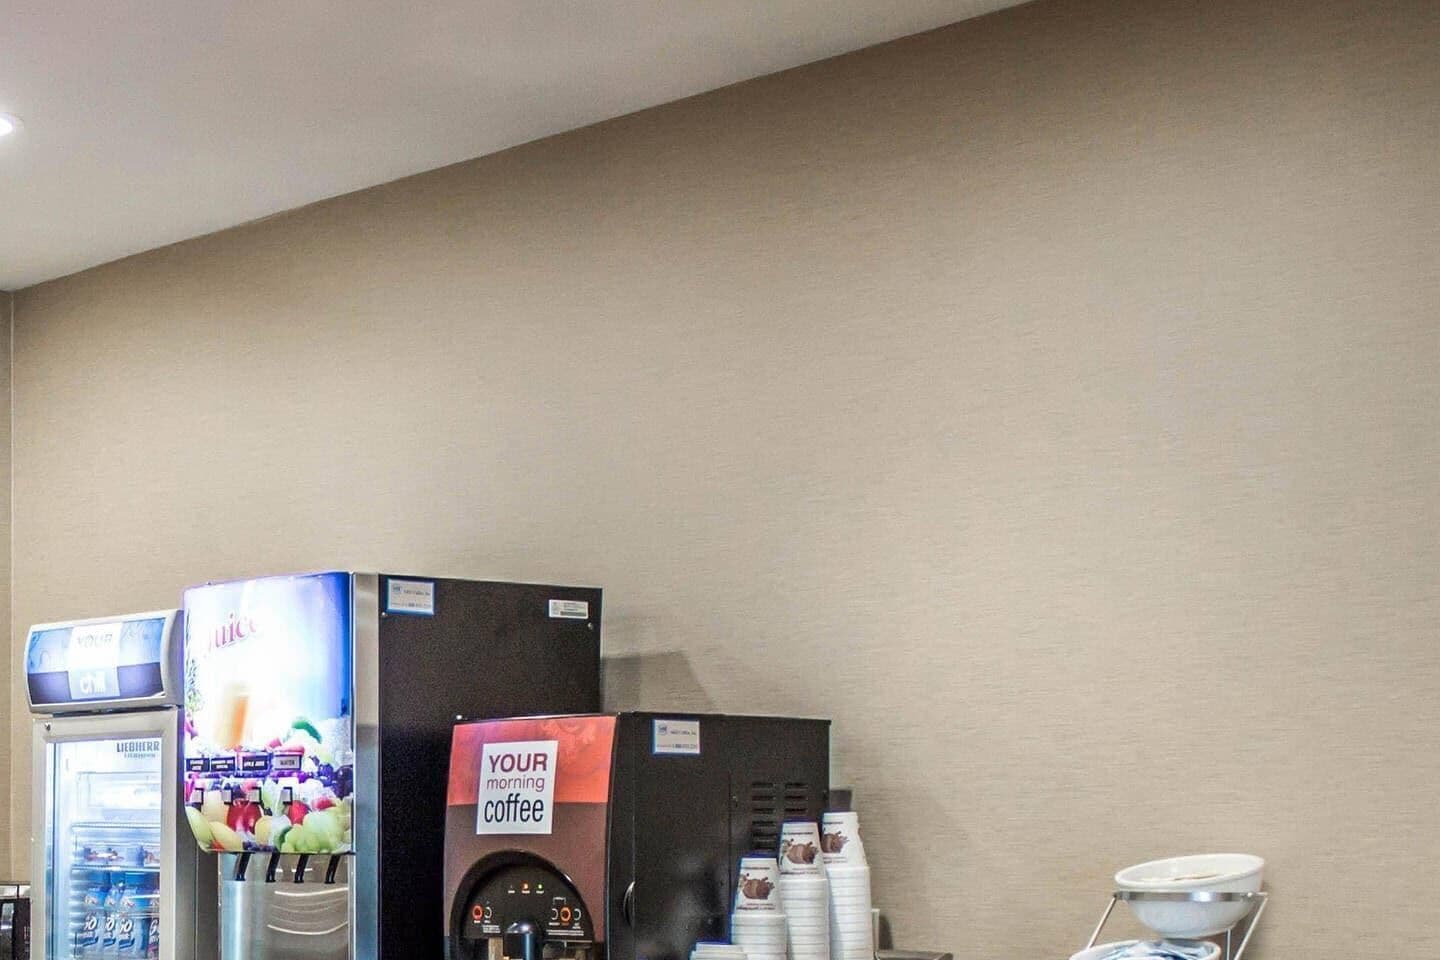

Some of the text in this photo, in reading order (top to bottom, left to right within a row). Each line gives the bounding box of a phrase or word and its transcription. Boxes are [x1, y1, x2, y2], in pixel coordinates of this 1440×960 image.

[116, 741, 160, 752] LIEBHERR
[488, 752, 548, 774] YOUR
[486, 774, 545, 793] morning
[484, 793, 545, 823] coffee
